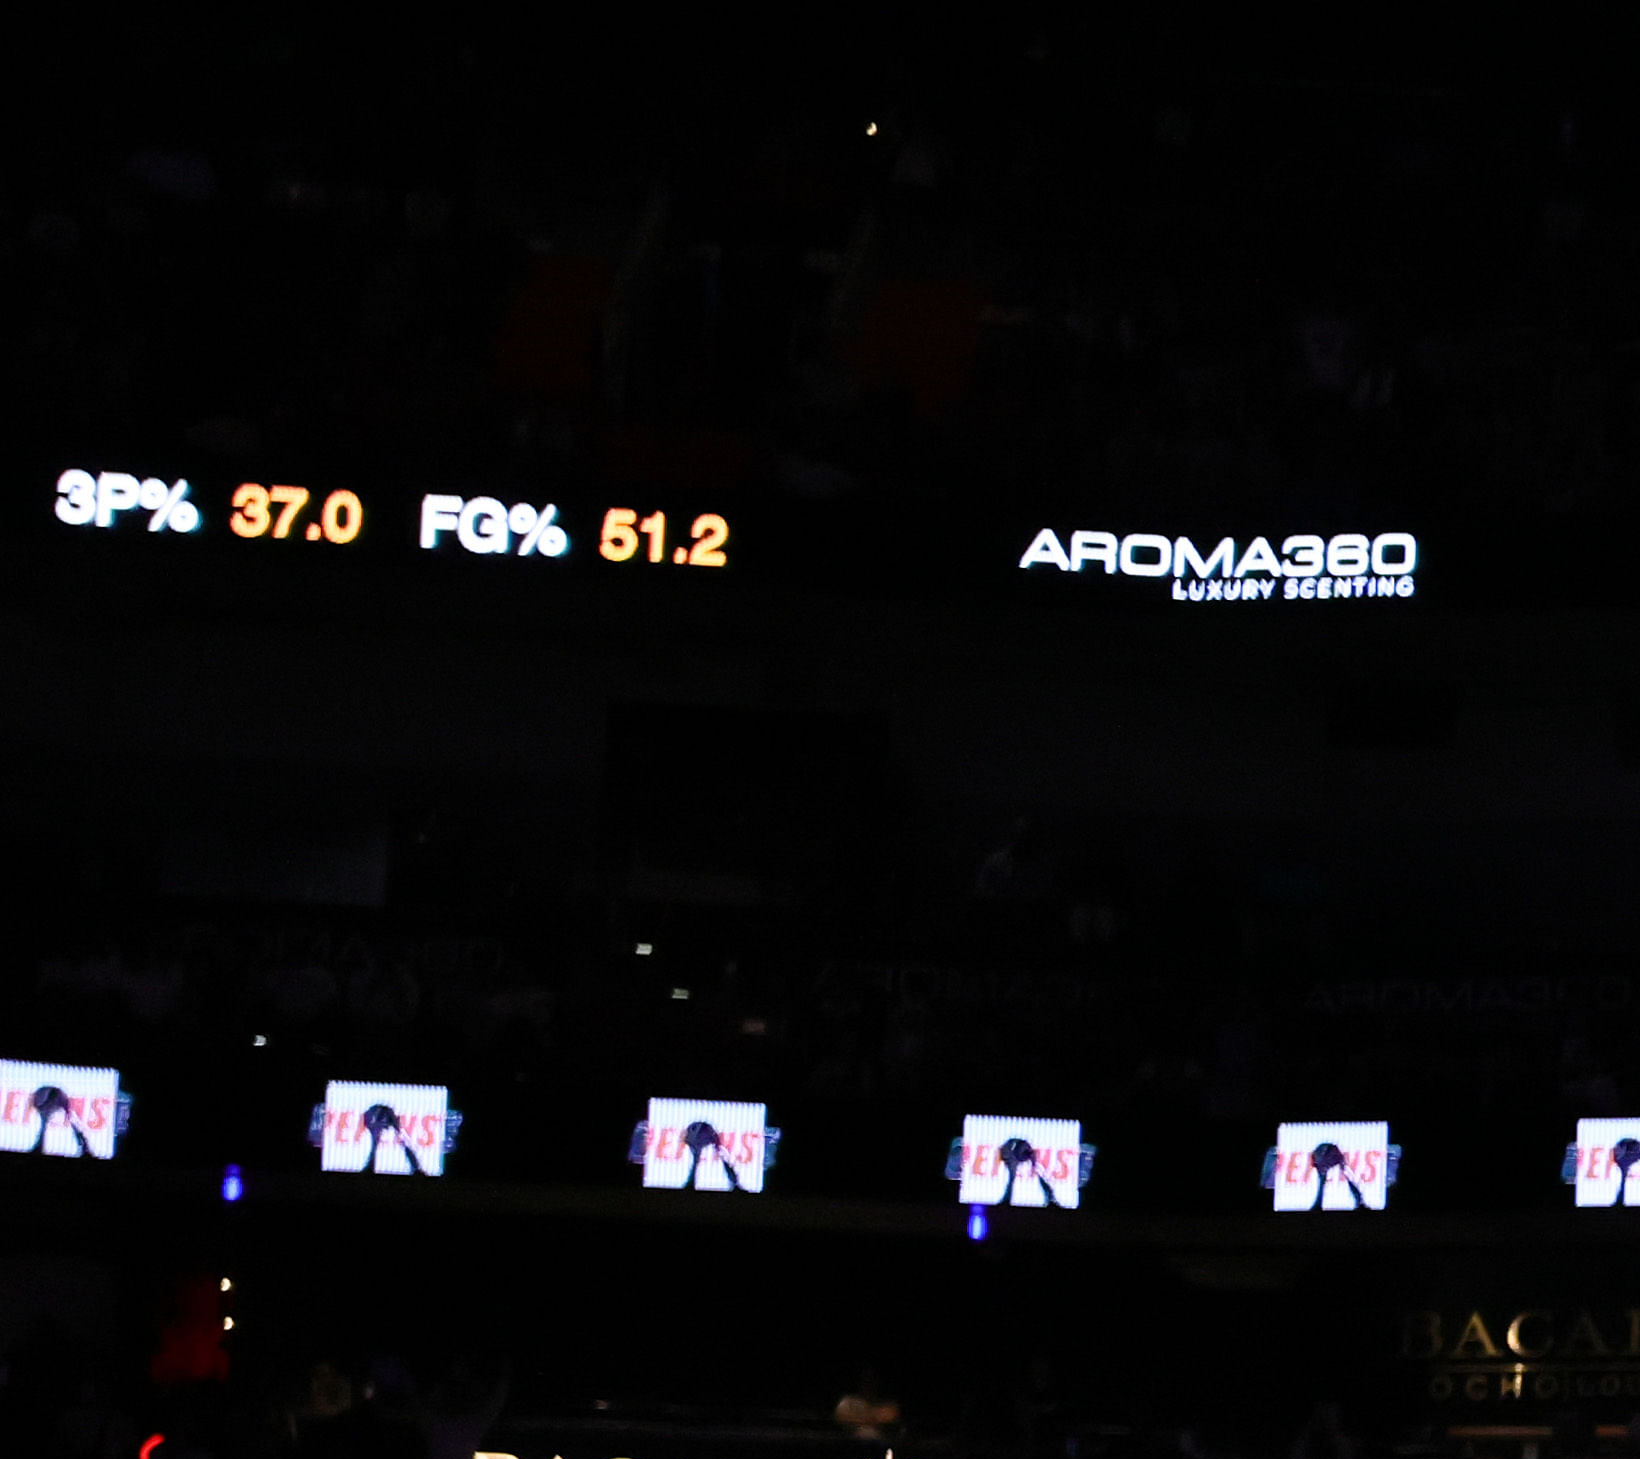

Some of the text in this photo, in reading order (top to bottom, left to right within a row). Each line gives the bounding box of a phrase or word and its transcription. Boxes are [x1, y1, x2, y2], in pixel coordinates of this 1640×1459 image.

[54, 468, 729, 567] 3P% 37.0 FG% 51.2
[1019, 528, 1416, 577] AROMA360
[1172, 576, 1414, 601] LUXURY SCENTING
